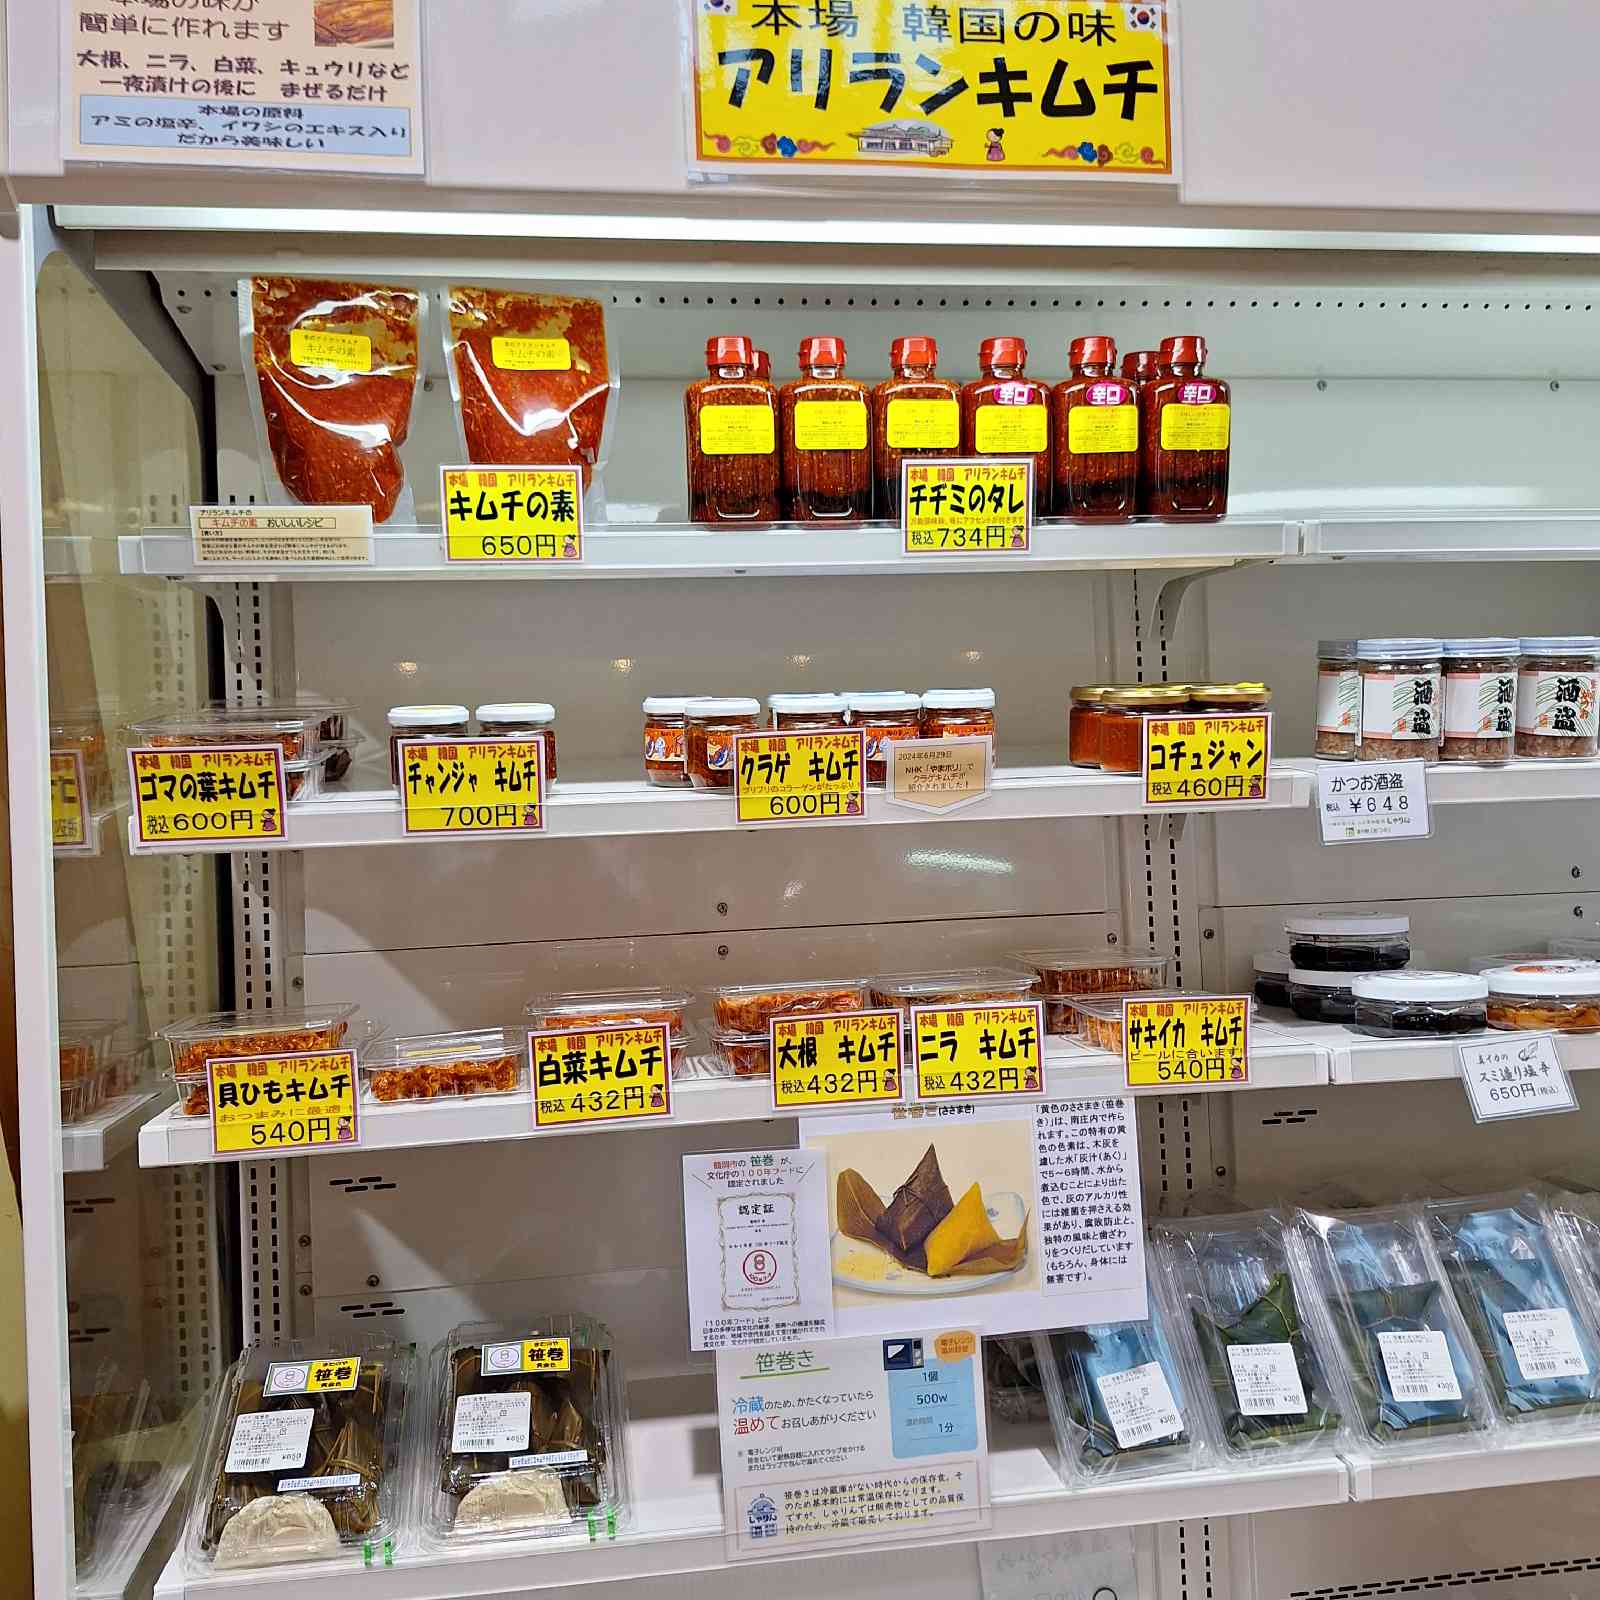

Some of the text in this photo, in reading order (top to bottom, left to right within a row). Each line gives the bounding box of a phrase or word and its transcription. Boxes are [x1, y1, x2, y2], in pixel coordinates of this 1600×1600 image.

[79, 12, 290, 41] 簡単に作れます
[752, 0, 1118, 46] 本場 韓国の味
[99, 74, 388, 103] 一夜漬けの後に まぜるだけ
[717, 47, 1158, 121] アリランキムチ
[198, 104, 304, 120] 本場の原料
[178, 134, 325, 149] だから美味しい
[448, 473, 468, 487] 本場
[508, 473, 576, 487] アリランキムチ
[910, 468, 928, 481] 本場
[964, 468, 1026, 480] アリランキムチ
[450, 490, 575, 522] キムチの素
[910, 483, 1025, 515] チヂミのタレ
[482, 534, 556, 557] 650円
[1152, 722, 1170, 736] 本場
[1204, 720, 1264, 734] アリランキムチ
[406, 748, 428, 761] 本場
[469, 745, 536, 760] アリランキムチ
[741, 741, 759, 753] 本場
[796, 736, 860, 750] アリランキムチ
[1151, 739, 1263, 771] コチュジャン
[138, 754, 160, 770] 本場
[202, 752, 274, 768] アリランキムチ
[741, 749, 859, 785] クラゲ キムチ
[140, 770, 276, 802] ゴマの葉キムチ
[408, 760, 536, 795] チャンジャ キムチ
[1330, 773, 1404, 792] かつお酒盗
[770, 792, 840, 816] 600円
[440, 804, 516, 827] 700円
[920, 1014, 938, 1028] 本場
[974, 1010, 1035, 1024] アリランキムチ
[1130, 1004, 1148, 1018] 本場
[1184, 1002, 1244, 1016] アリランキムチ
[778, 1024, 797, 1038] 本場
[834, 1016, 896, 1032] アリランキムチ
[1130, 1016, 1242, 1050] サキイカ キムチ
[537, 1040, 558, 1053] 本場
[596, 1030, 662, 1046] アリランキムチ
[778, 1032, 896, 1070] 大根 キムチ
[920, 1026, 1036, 1062] ニラ キムチ
[215, 1065, 237, 1079] 本場
[278, 1056, 350, 1074] アリランキムチ
[539, 1046, 662, 1087] 白菜キムチ
[1158, 1058, 1224, 1080] 540円
[218, 1074, 350, 1108] 貝ひもキムチ
[252, 1118, 330, 1145] 540円
[1038, 1125, 1126, 1140] れます。この特有の黄
[1038, 1138, 1119, 1154] 色の色素は、木灰を
[750, 1154, 774, 1167] 笹巻
[728, 1177, 784, 1188] 認定されました
[1042, 1190, 1128, 1206] 色で、灰のアルカリ性
[739, 1203, 775, 1216] 認定証
[1046, 1242, 1134, 1258] りをつくりだしています
[529, 1348, 564, 1362] 笹巻
[756, 1350, 815, 1374] 笹巻き
[314, 1366, 352, 1382] 笹巻
[922, 1370, 939, 1382] 1個
[732, 1390, 874, 1414] 冷蔵のため、かたくなっていたら
[916, 1393, 948, 1405] 500w
[734, 1411, 876, 1436] 温めてお召しあがりください
[938, 1422, 954, 1432] 1分
